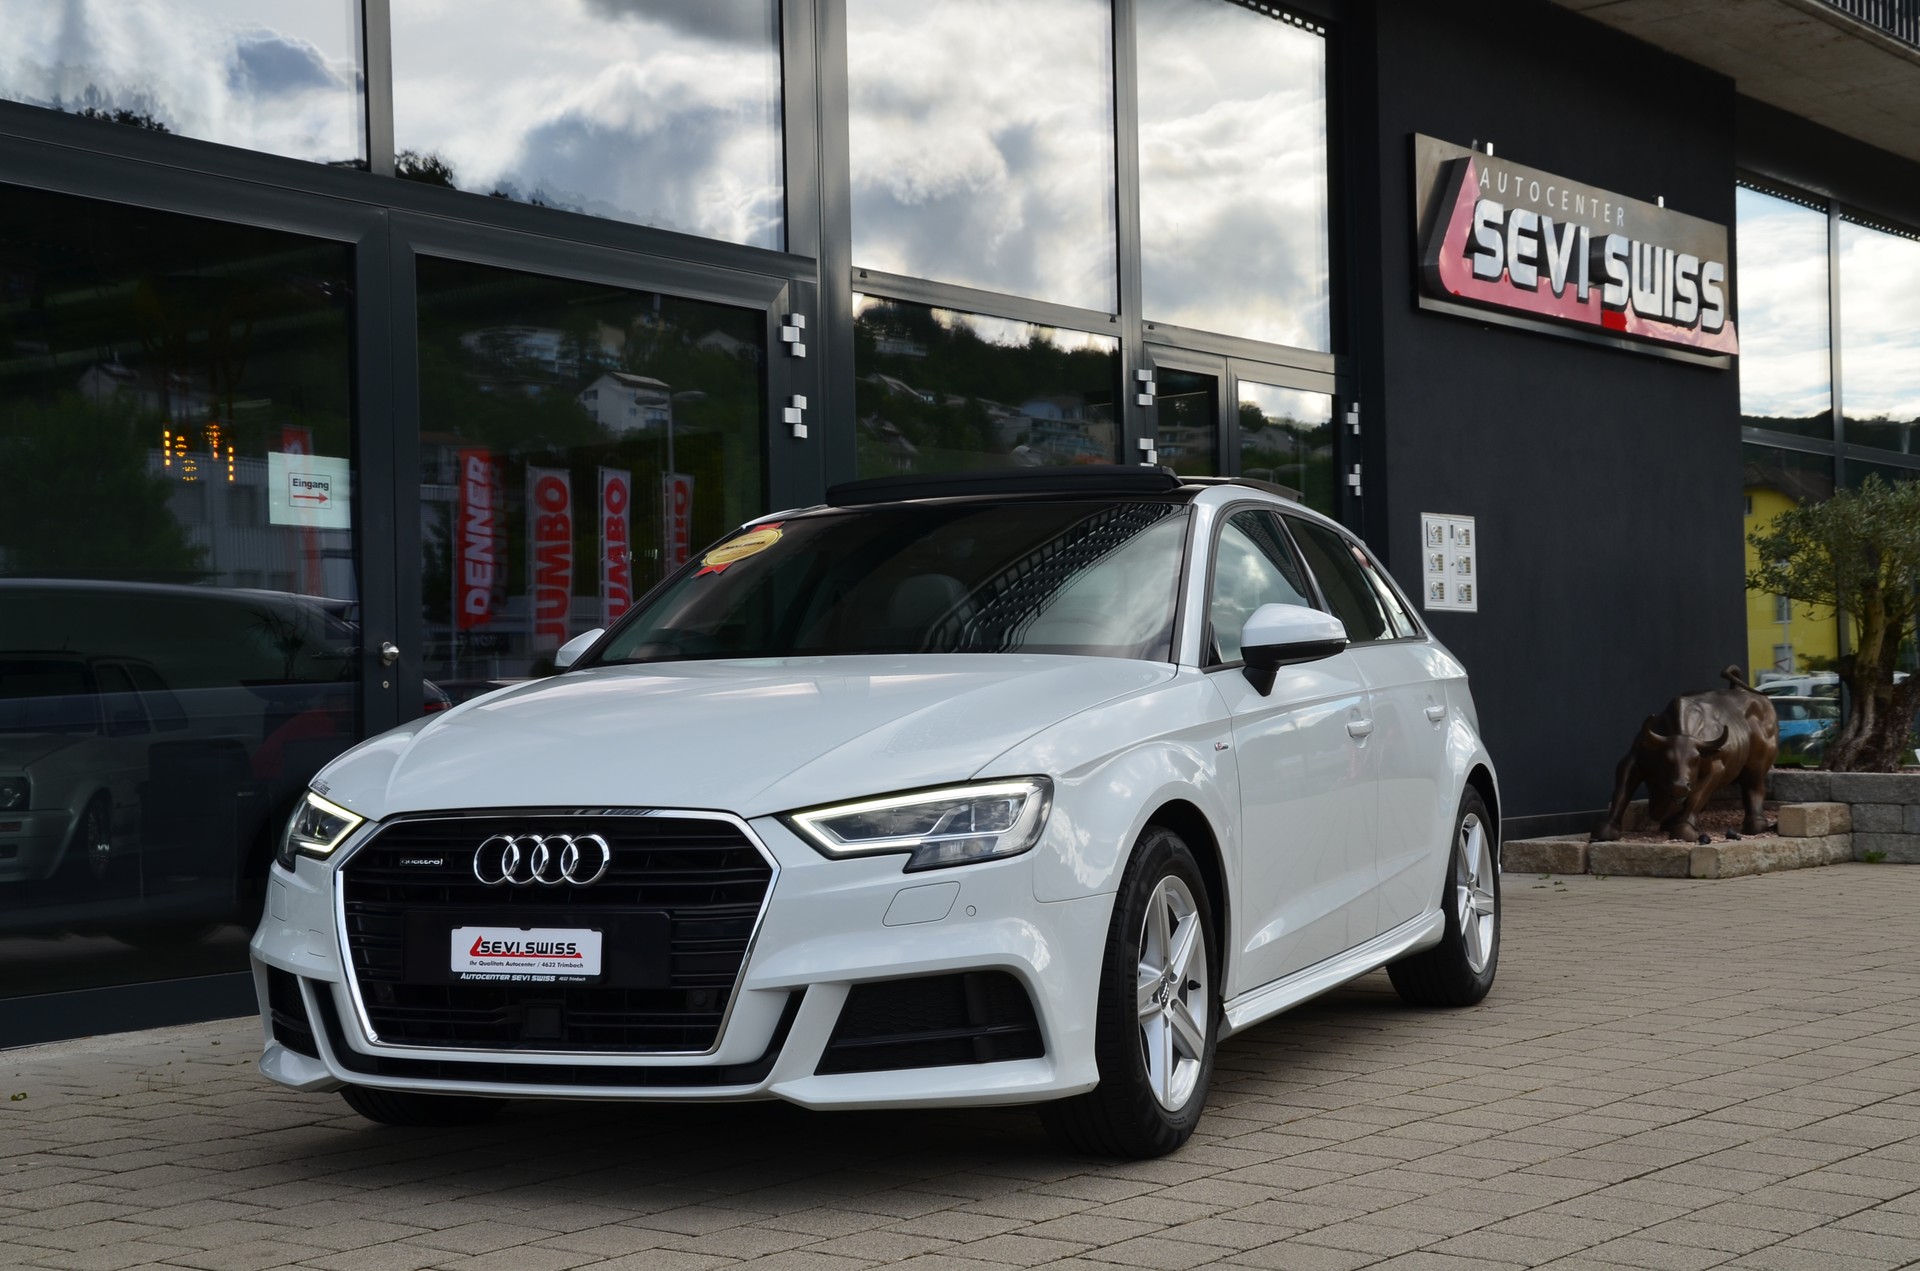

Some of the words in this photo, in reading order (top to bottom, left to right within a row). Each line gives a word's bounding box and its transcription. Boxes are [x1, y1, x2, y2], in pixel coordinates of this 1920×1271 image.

[1479, 166, 1625, 228] AUTOCENTER
[1472, 198, 1591, 302] SEVI
[1603, 232, 1726, 331] SWISS
[292, 478, 329, 491] Eingang
[464, 456, 494, 616] DENNER
[535, 476, 570, 644] JUMBO
[605, 478, 630, 624] UMBO
[480, 941, 520, 954] SEVI
[525, 942, 577, 955] SWISS
[511, 974, 531, 982] SEVI
